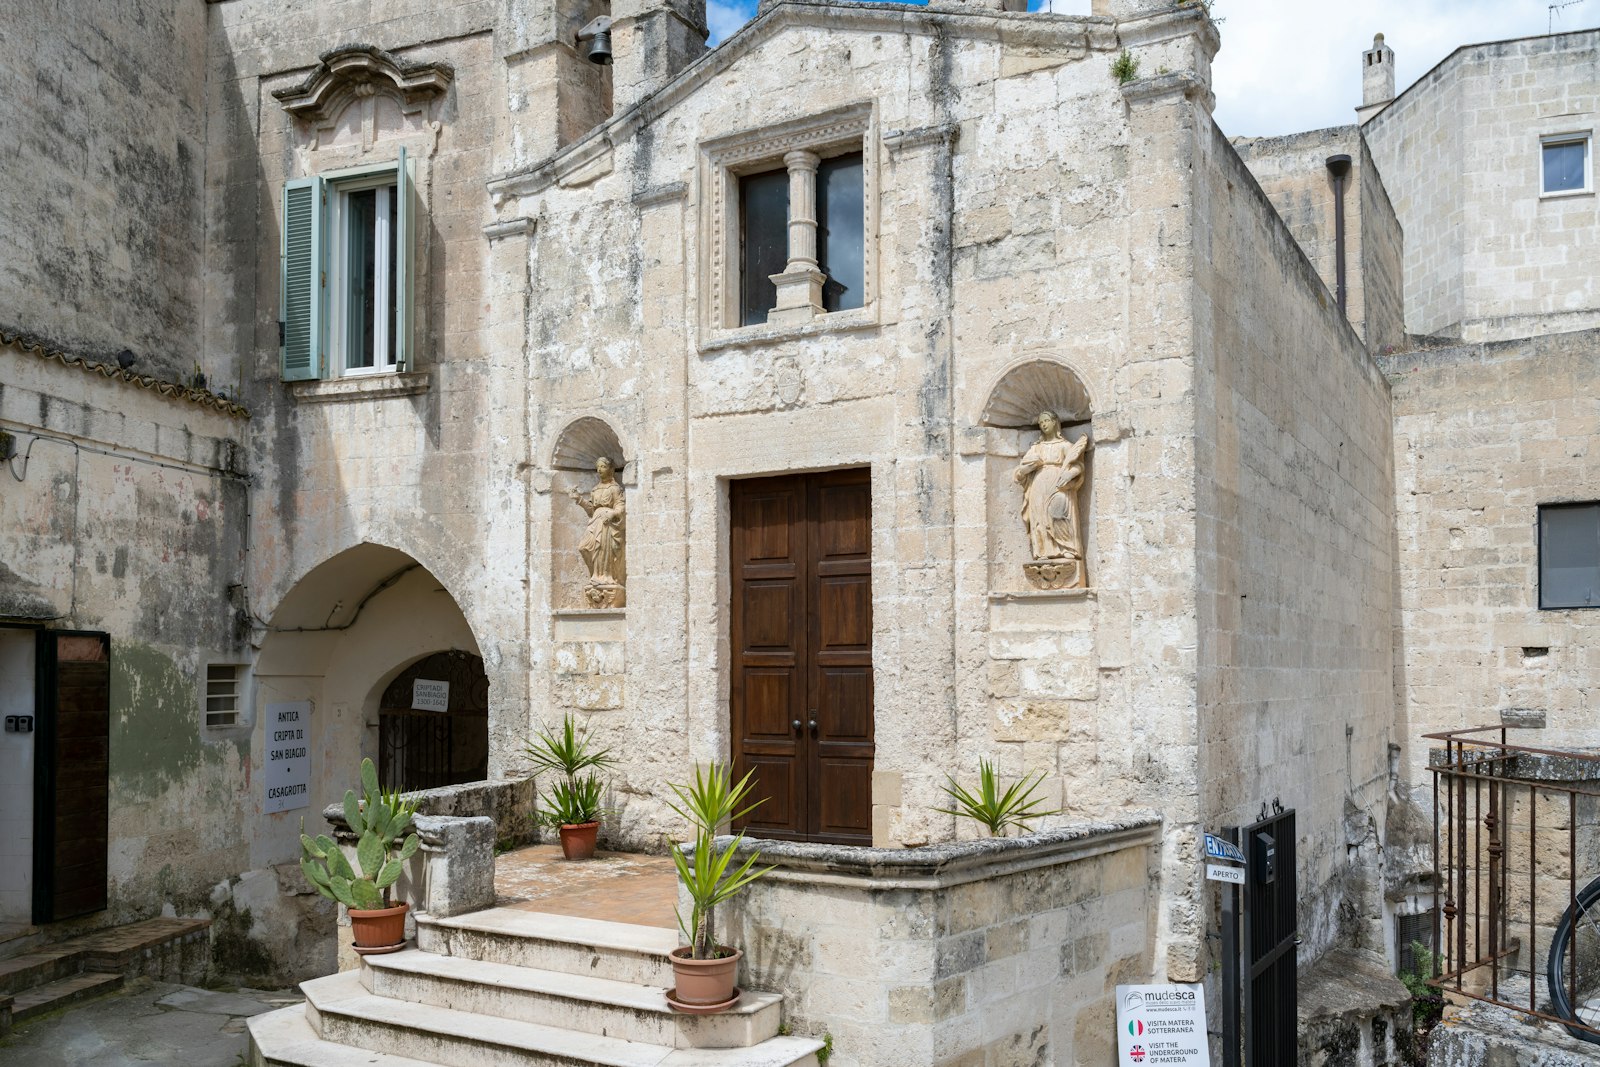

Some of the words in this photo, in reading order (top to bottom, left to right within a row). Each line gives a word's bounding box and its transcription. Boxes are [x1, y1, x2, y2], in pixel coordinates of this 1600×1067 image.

[278, 711, 299, 722] ANTICA
[274, 730, 295, 742] CRIPTA
[296, 729, 303, 739] DI
[271, 750, 284, 761] SAN
[285, 747, 306, 760] BIAGIO
[268, 783, 307, 799] CASAGROTTA
[1212, 870, 1239, 880] APERTO
[1144, 990, 1195, 1001] mudesca
[1147, 1027, 1194, 1035] SOTTERRANEA
[1149, 1048, 1199, 1057] UNDERGROUND
